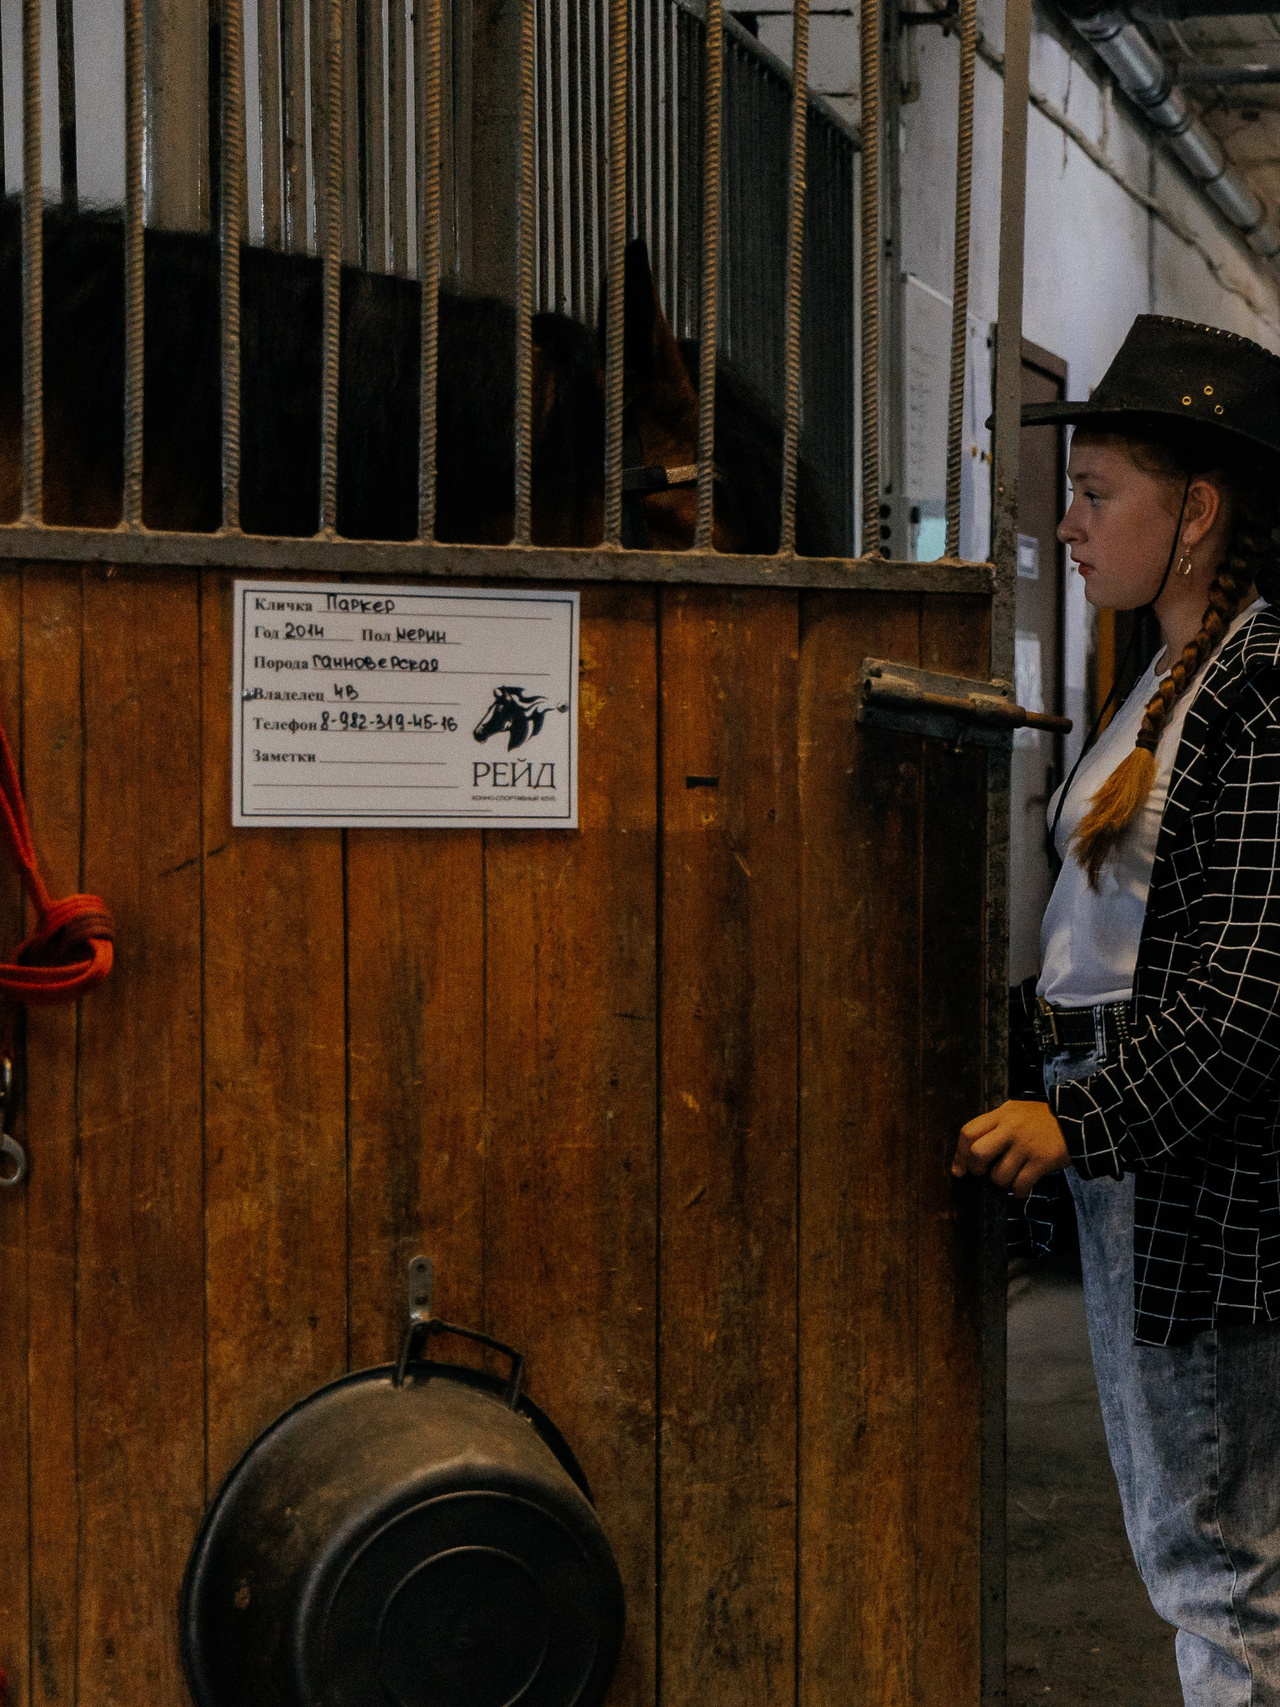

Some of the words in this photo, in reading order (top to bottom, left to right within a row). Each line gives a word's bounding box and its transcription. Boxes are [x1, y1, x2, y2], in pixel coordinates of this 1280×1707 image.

[255, 597, 313, 612] Кличка
[326, 593, 395, 614] Паркер
[254, 625, 280, 640] Год
[362, 629, 391, 642] Пол
[254, 655, 309, 672] Порода
[254, 687, 325, 703] Владелец
[253, 717, 318, 734] Телефон
[253, 749, 317, 764] Заметки
[473, 758, 557, 789] РЕЙД
